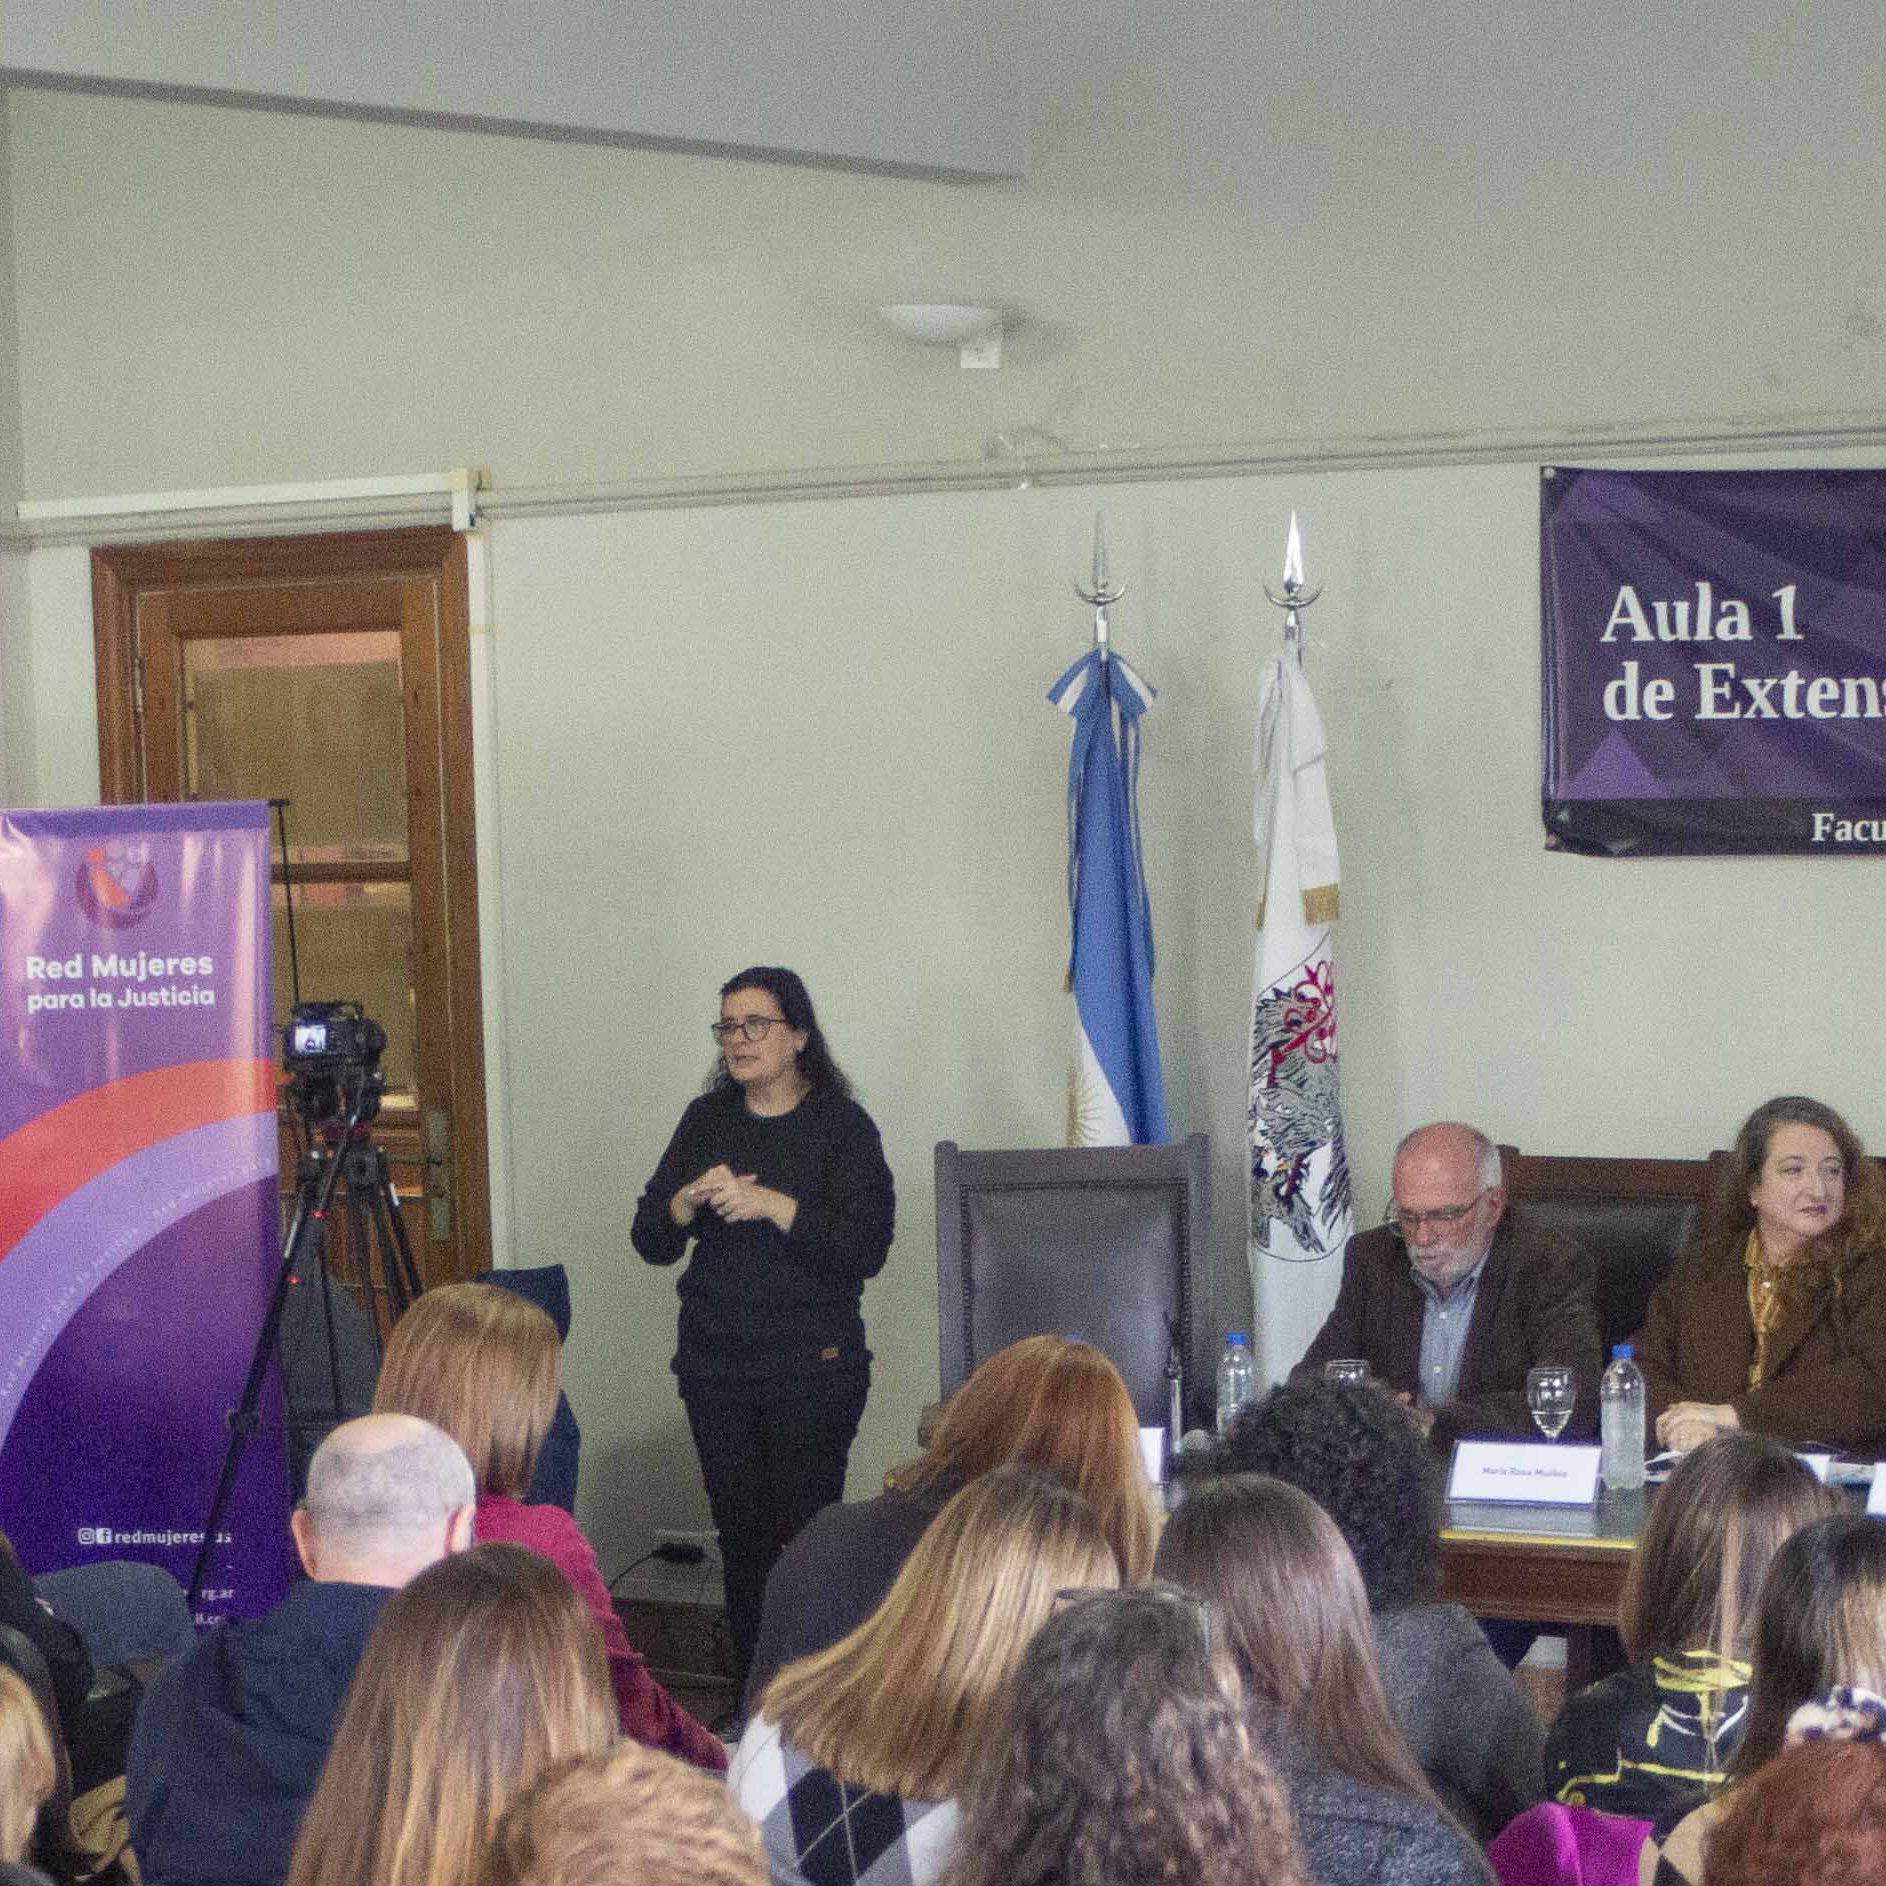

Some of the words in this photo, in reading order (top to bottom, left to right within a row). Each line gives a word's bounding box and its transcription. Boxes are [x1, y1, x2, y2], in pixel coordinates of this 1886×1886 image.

[1600, 581, 1754, 642] Aula
[1771, 584, 1804, 640] 1
[1603, 660, 1676, 721] de
[25, 953, 83, 979] Red
[91, 951, 213, 981] Mujeres
[27, 991, 85, 1014] para
[90, 988, 112, 1008] la
[117, 985, 215, 1007] Justicia
[116, 1529, 232, 1546] redmujeresus
